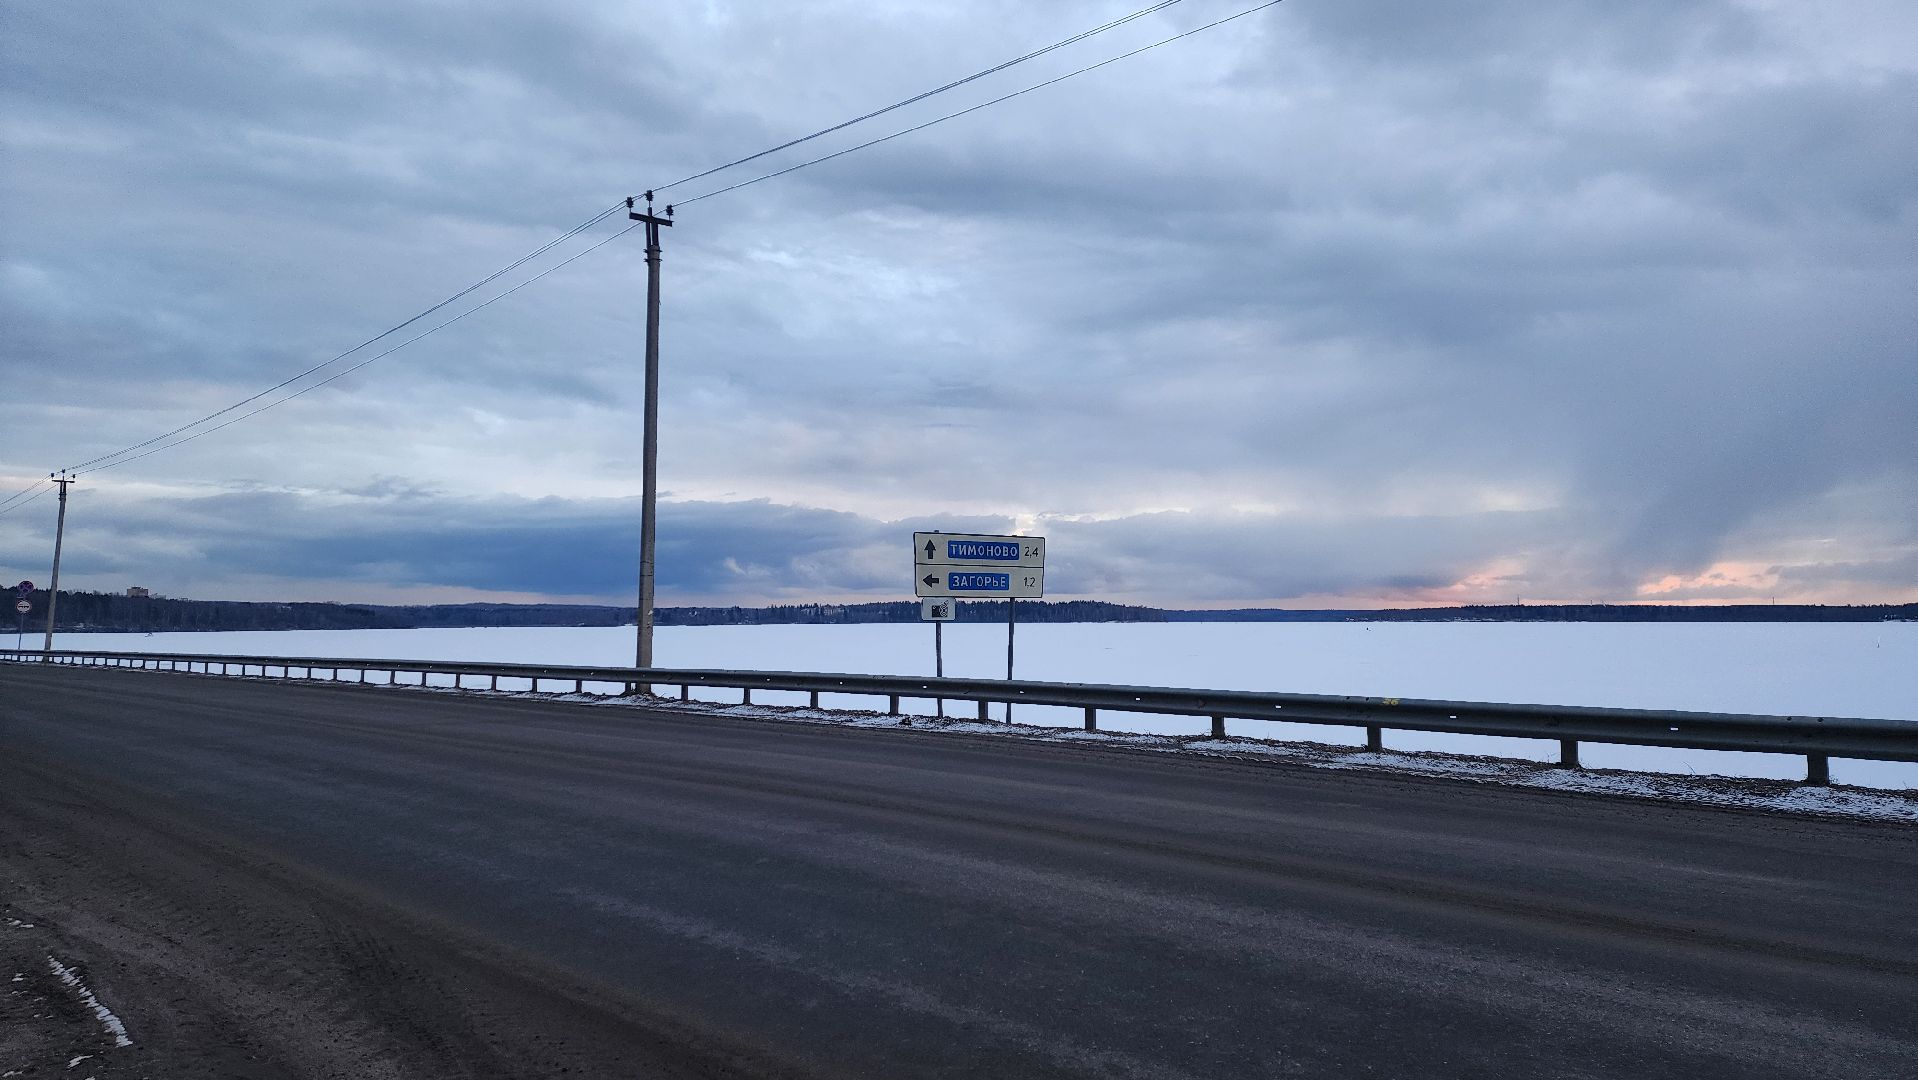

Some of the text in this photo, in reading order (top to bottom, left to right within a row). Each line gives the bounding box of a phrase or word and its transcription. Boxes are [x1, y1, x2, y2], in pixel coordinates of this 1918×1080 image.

[950, 544, 1039, 558] ТИМОНОВО 2,4
[952, 575, 1036, 589] ЗАГОРЬЕ 1,2
